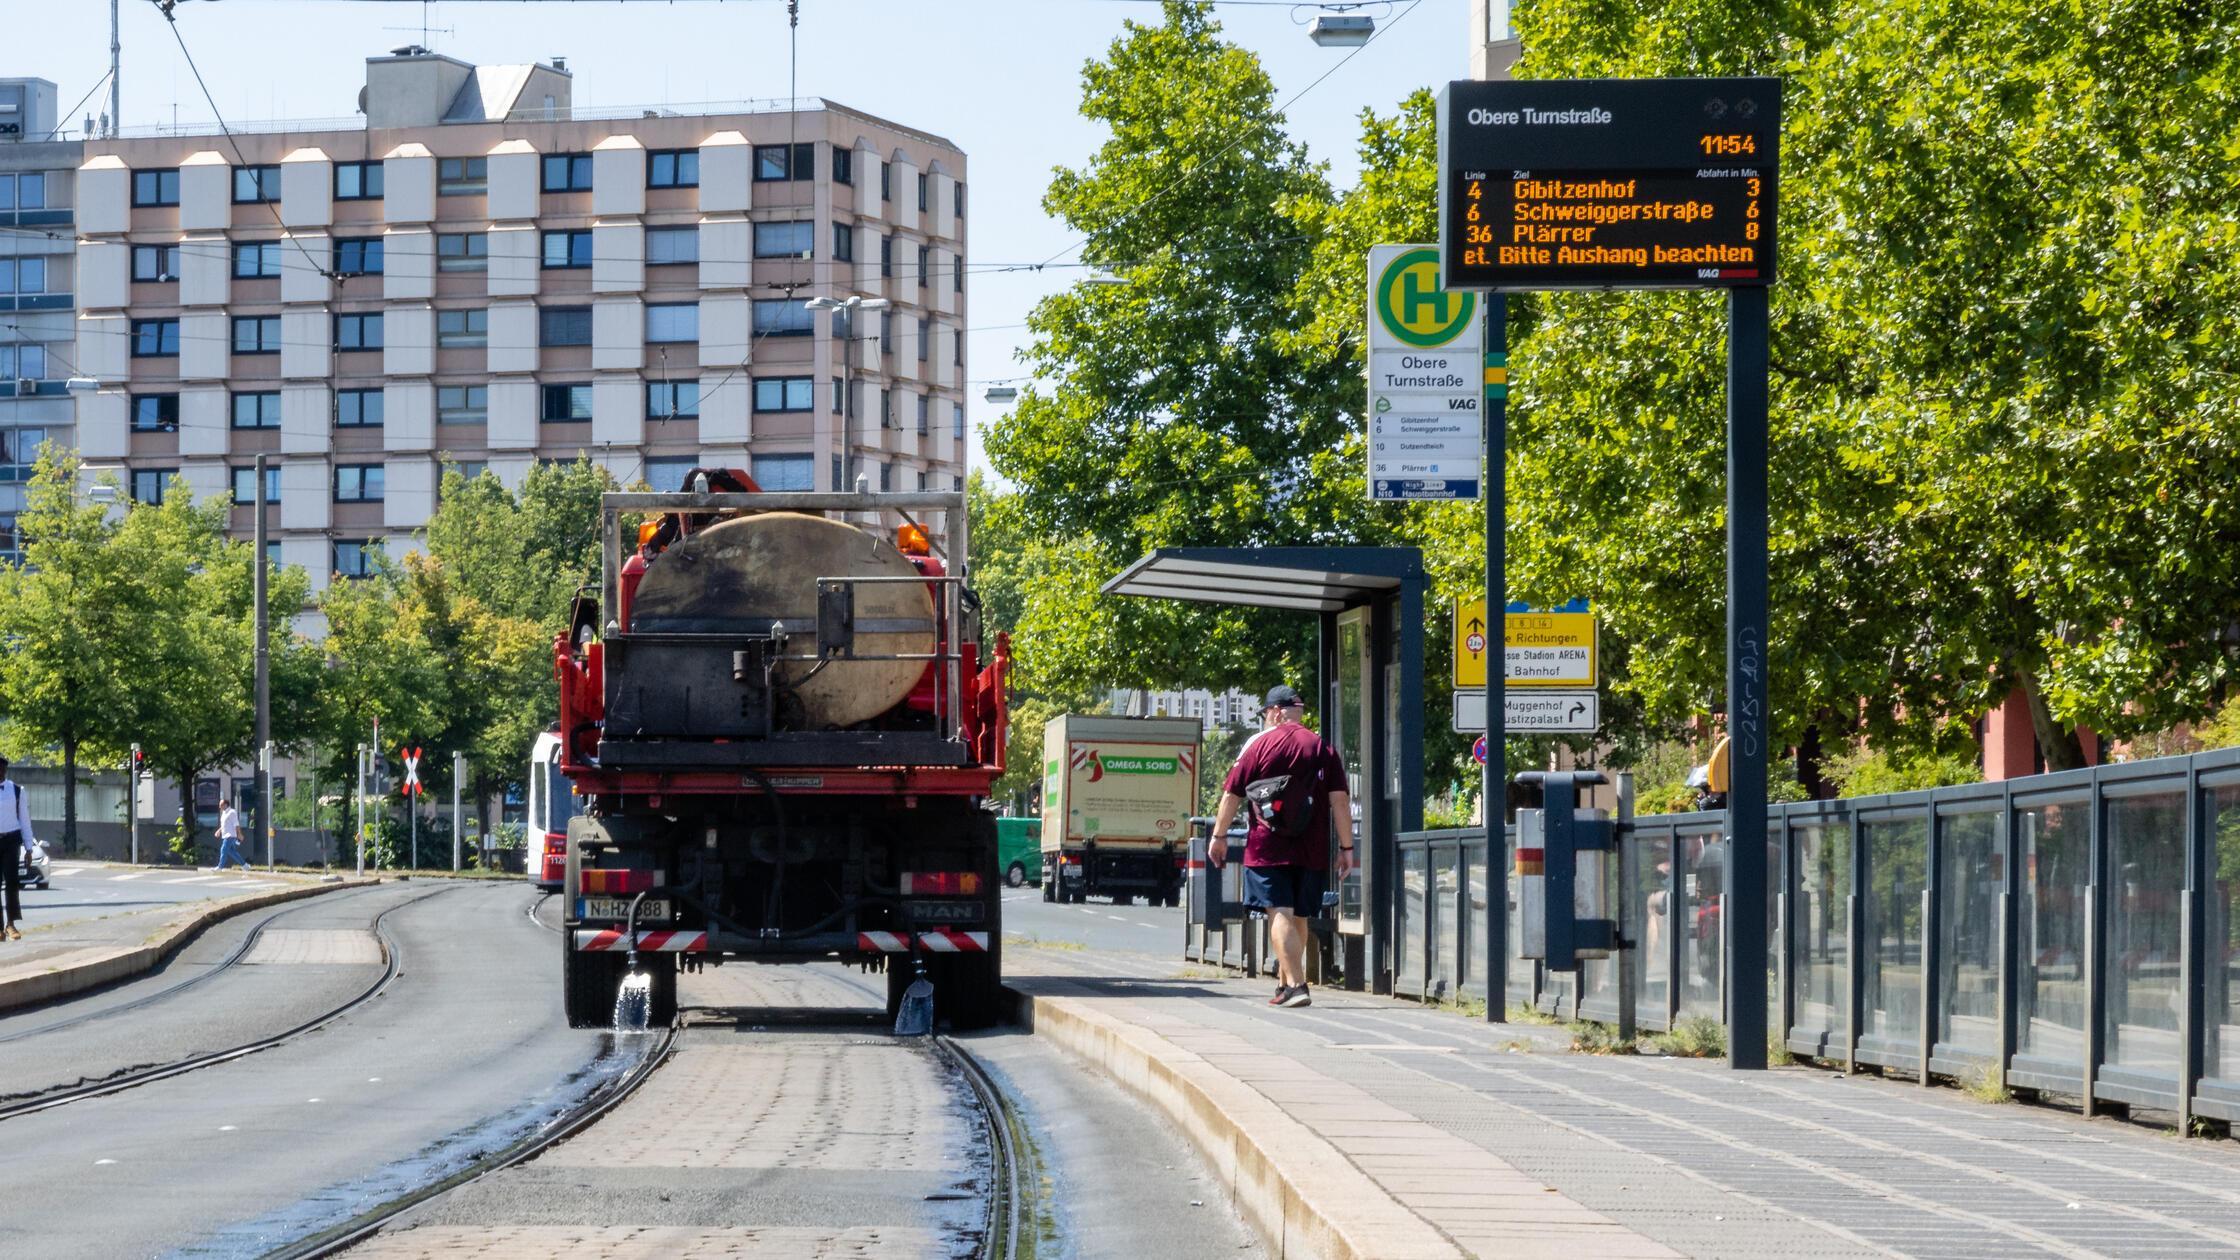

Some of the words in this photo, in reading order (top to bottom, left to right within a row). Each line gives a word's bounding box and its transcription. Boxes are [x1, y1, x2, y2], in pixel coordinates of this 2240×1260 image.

[1467, 107, 1520, 125] Obere
[1522, 107, 1612, 124] Turnstraße
[1700, 135, 1756, 155] 11:54
[1464, 171, 1486, 180] Linie
[1512, 170, 1530, 180] Ziel
[1696, 169, 1729, 178] Abfahrt
[1730, 169, 1739, 178] in
[1740, 168, 1760, 177] Min.
[1467, 180, 1482, 199] 4
[1514, 180, 1636, 199] Gibitzenhof
[1747, 178, 1760, 197] 3
[1467, 203, 1480, 222] 6
[1514, 200, 1714, 224] Schweiggerstraße
[1746, 200, 1760, 219] 6
[1466, 224, 1493, 243] 36
[1513, 224, 1597, 243] Plärrer
[1745, 222, 1760, 241] 8
[1464, 246, 1492, 265] et.
[1499, 246, 1551, 265] Bitte
[1557, 245, 1648, 267] Aushang
[1653, 244, 1754, 263] beachten
[1697, 269, 1720, 278] VAG
[1403, 271, 1449, 325] H
[1401, 356, 1447, 369] Obere
[1385, 374, 1464, 387] Turnstraße
[1448, 398, 1477, 410] VAG
[1376, 417, 1382, 425] 4
[1376, 425, 1382, 434] 6
[1376, 443, 1385, 451] 10
[1375, 464, 1387, 472] 36
[1516, 632, 1578, 646] Richtungen
[1506, 651, 1520, 660] sse
[1524, 650, 1555, 660] Stadion
[1559, 650, 1586, 660] ARENA
[1514, 666, 1560, 676] Bahnhof
[1504, 714, 1563, 726] ustizpalast
[1106, 760, 1142, 769] OMEGA
[1145, 761, 1173, 770] SORG
[590, 902, 601, 916] N
[912, 905, 973, 918] MAN
